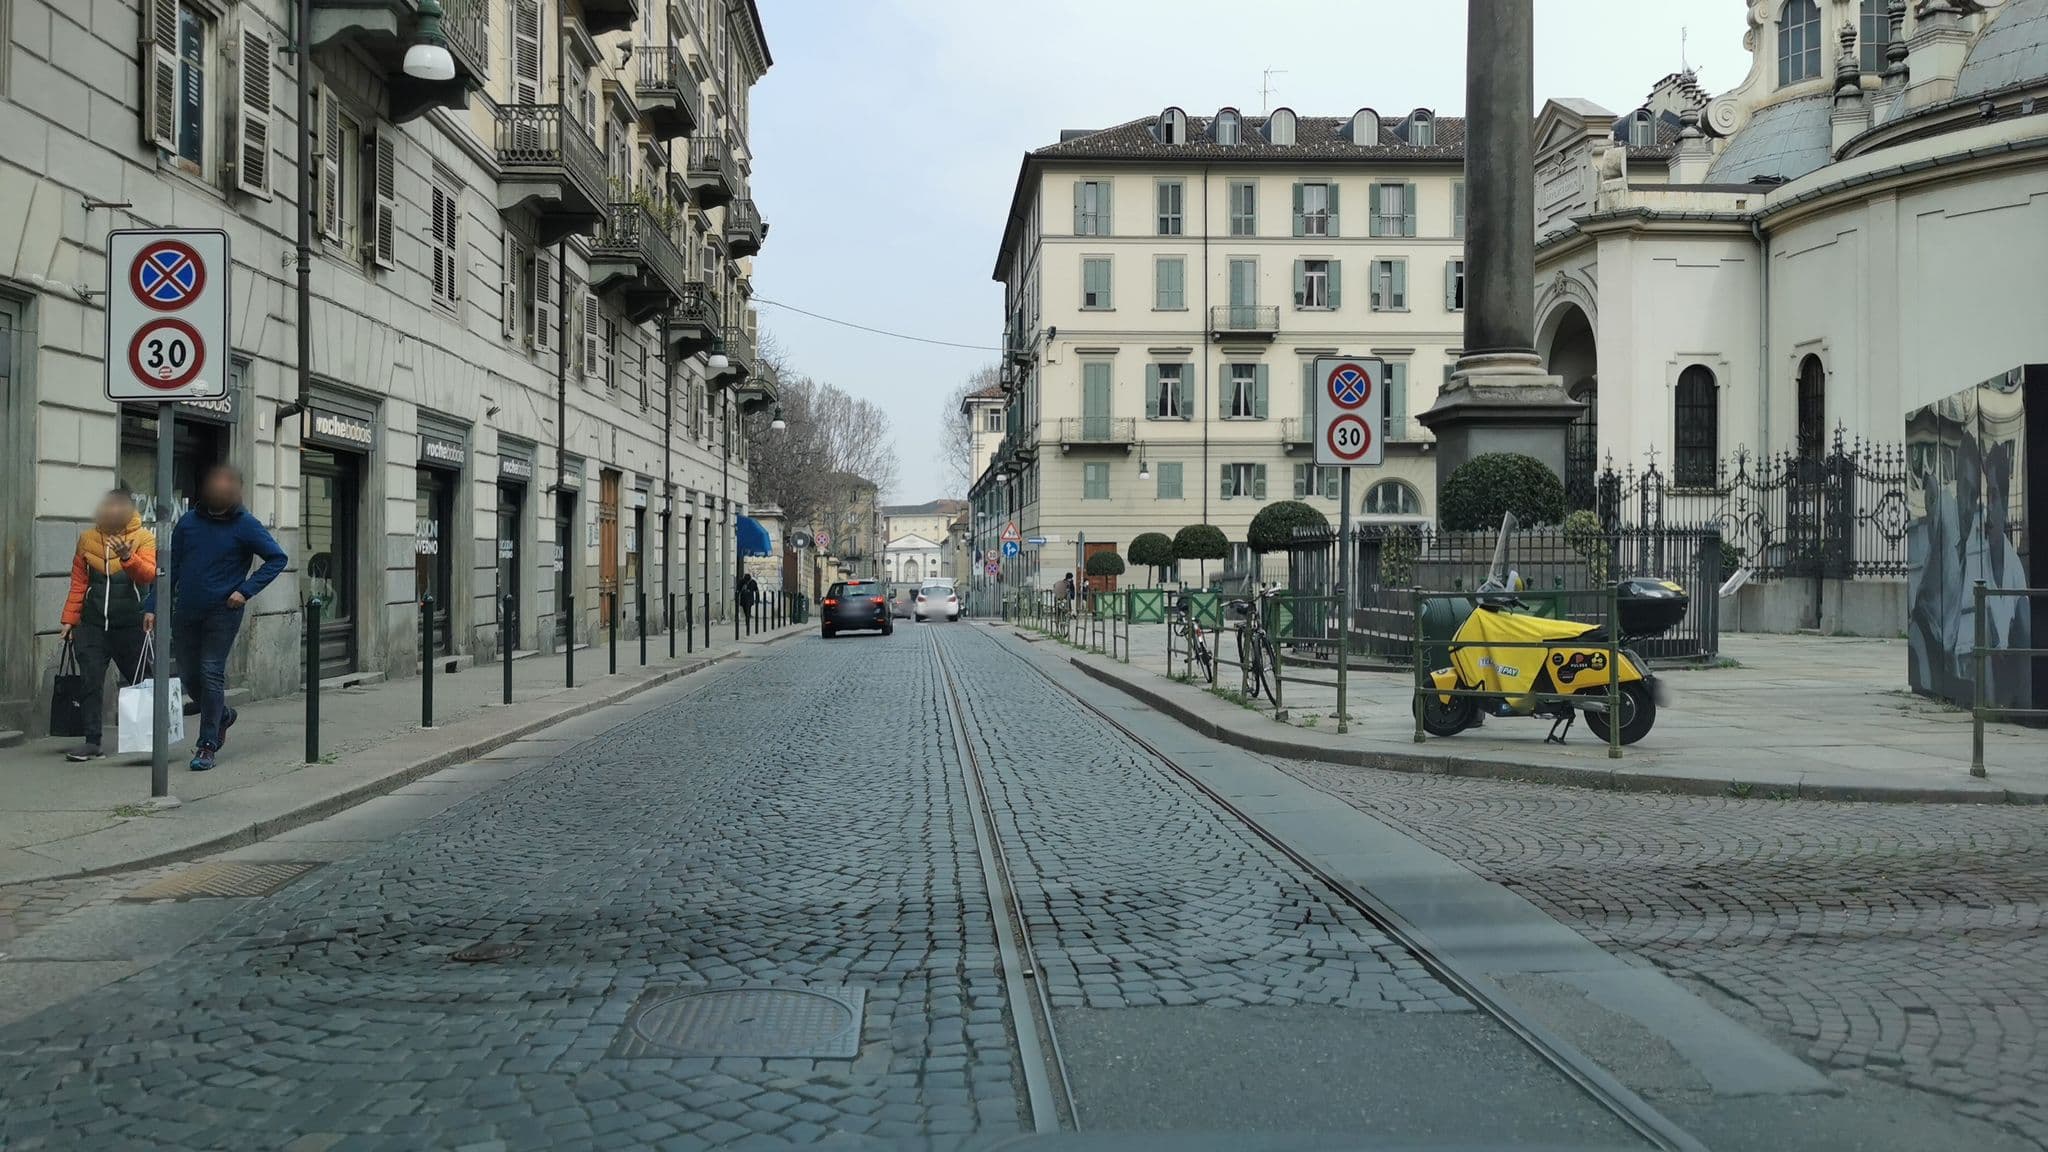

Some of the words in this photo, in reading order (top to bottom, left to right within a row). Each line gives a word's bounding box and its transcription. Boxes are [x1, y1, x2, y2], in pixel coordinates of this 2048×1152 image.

[147, 339, 187, 368] 30
[1338, 427, 1361, 447] 30
[1502, 666, 1519, 677] PAY
